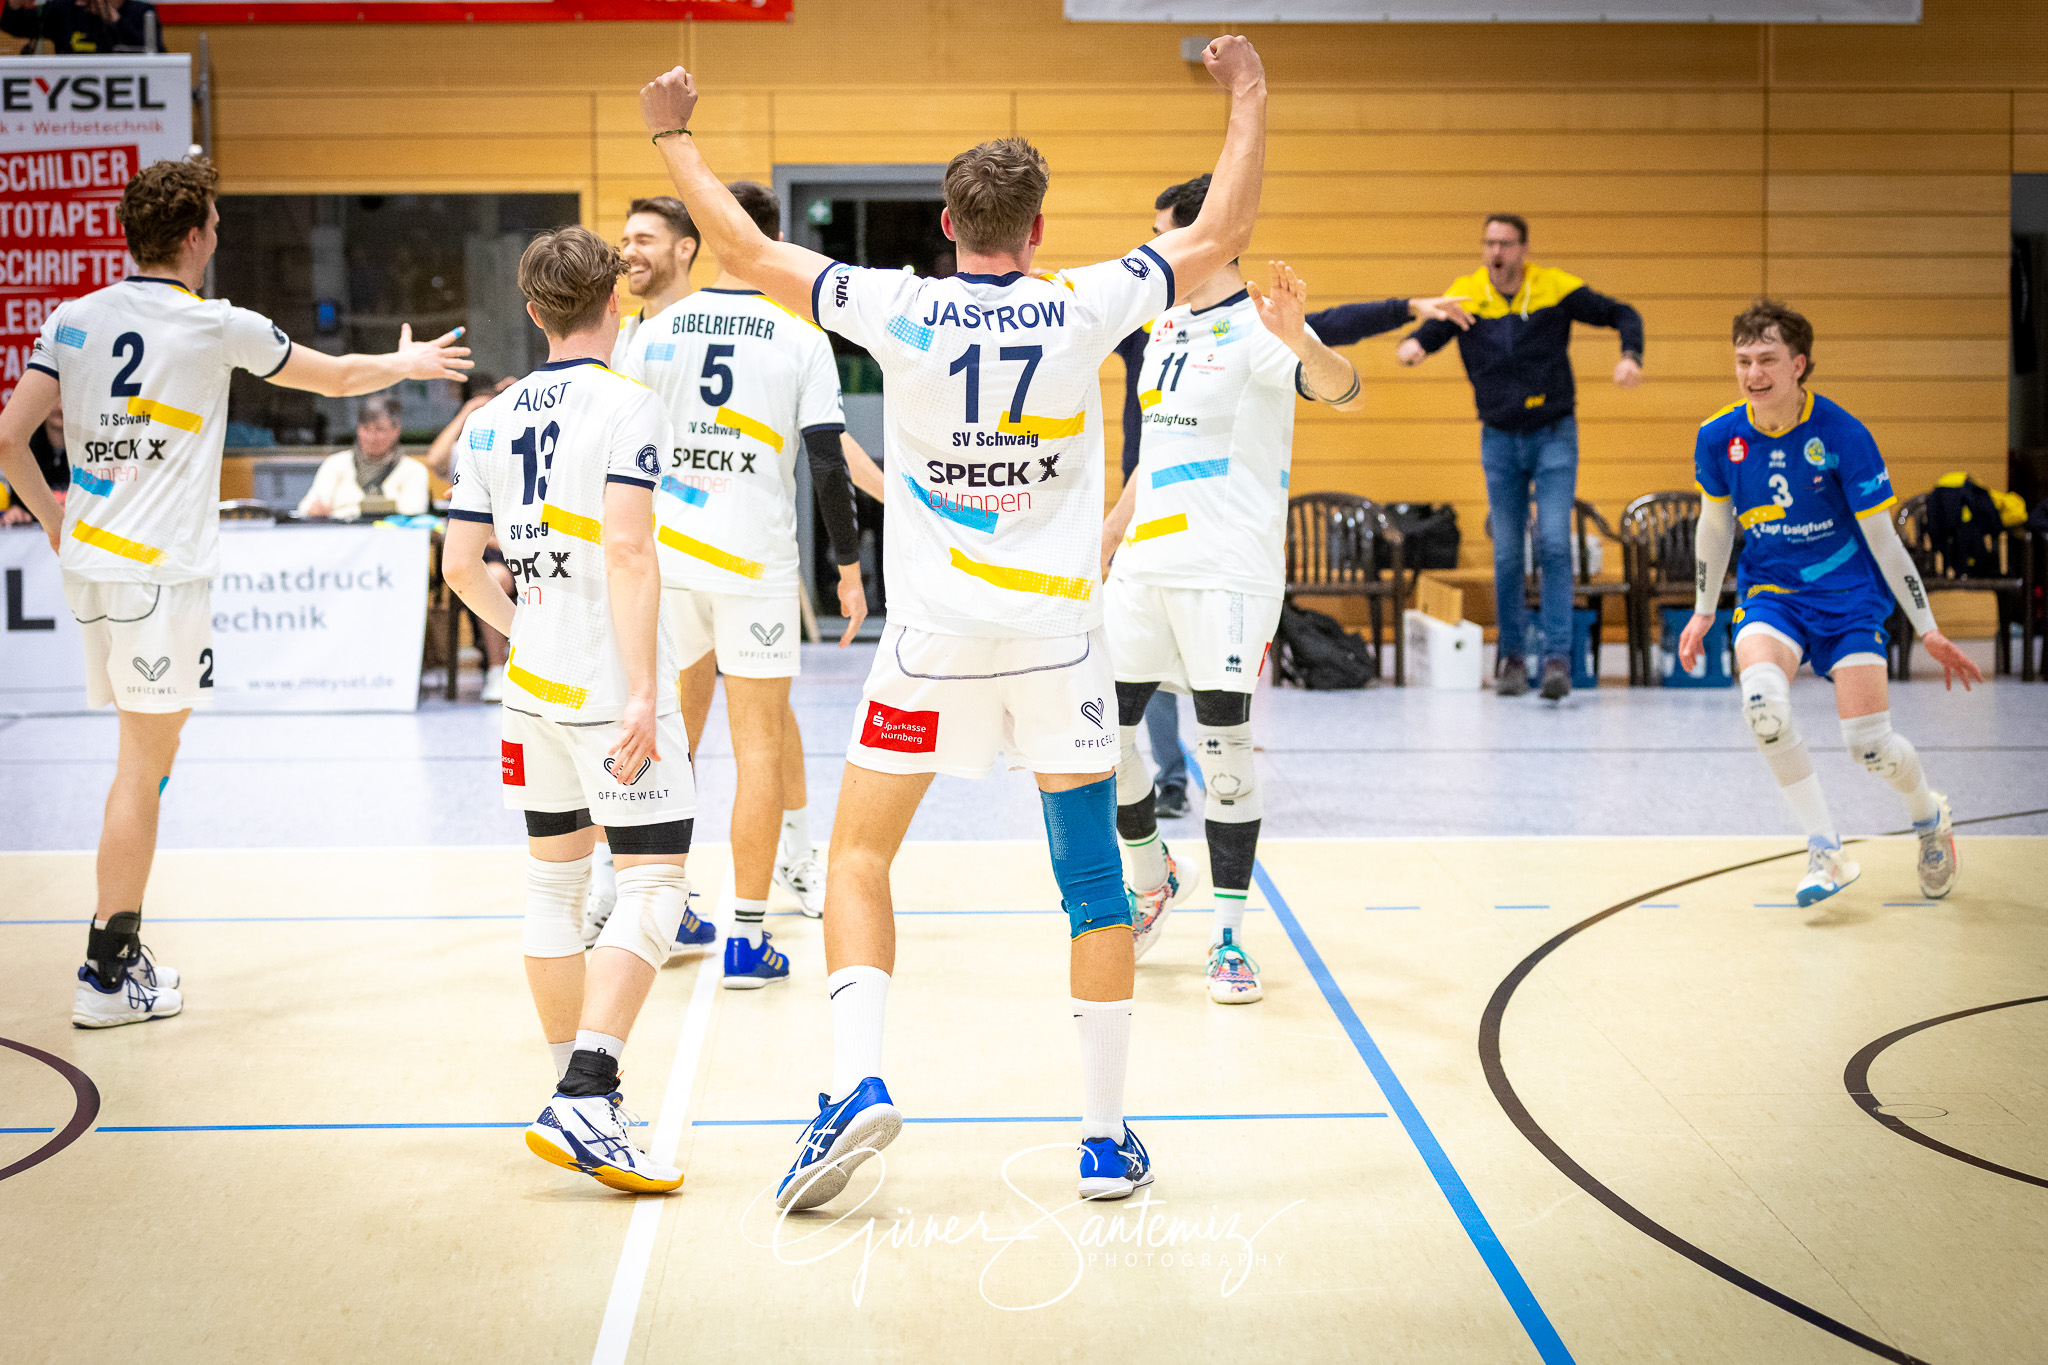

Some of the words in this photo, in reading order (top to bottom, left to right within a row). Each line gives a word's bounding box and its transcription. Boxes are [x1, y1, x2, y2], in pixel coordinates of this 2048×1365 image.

[33, 119, 163, 135] Werbetechnik
[836, 275, 849, 308] puls
[672, 313, 775, 340] BIBELRIETHER
[923, 300, 1065, 333] JASTROW
[110, 331, 145, 397] 2
[699, 343, 735, 407] 5
[1156, 352, 1189, 392] 11
[513, 381, 572, 412] AUST
[949, 343, 1043, 424] 17
[1153, 413, 1198, 427] Daigfuss
[952, 431, 970, 447] SV
[976, 430, 1039, 448] Schwaig
[927, 460, 1030, 488] SPECK
[1768, 473, 1793, 508] 3
[510, 524, 522, 540] SV
[199, 648, 213, 688] 2
[881, 732, 923, 745] Nürnberg
[883, 721, 927, 733] Sparkasse
[599, 789, 669, 801] OFFICEWELT
